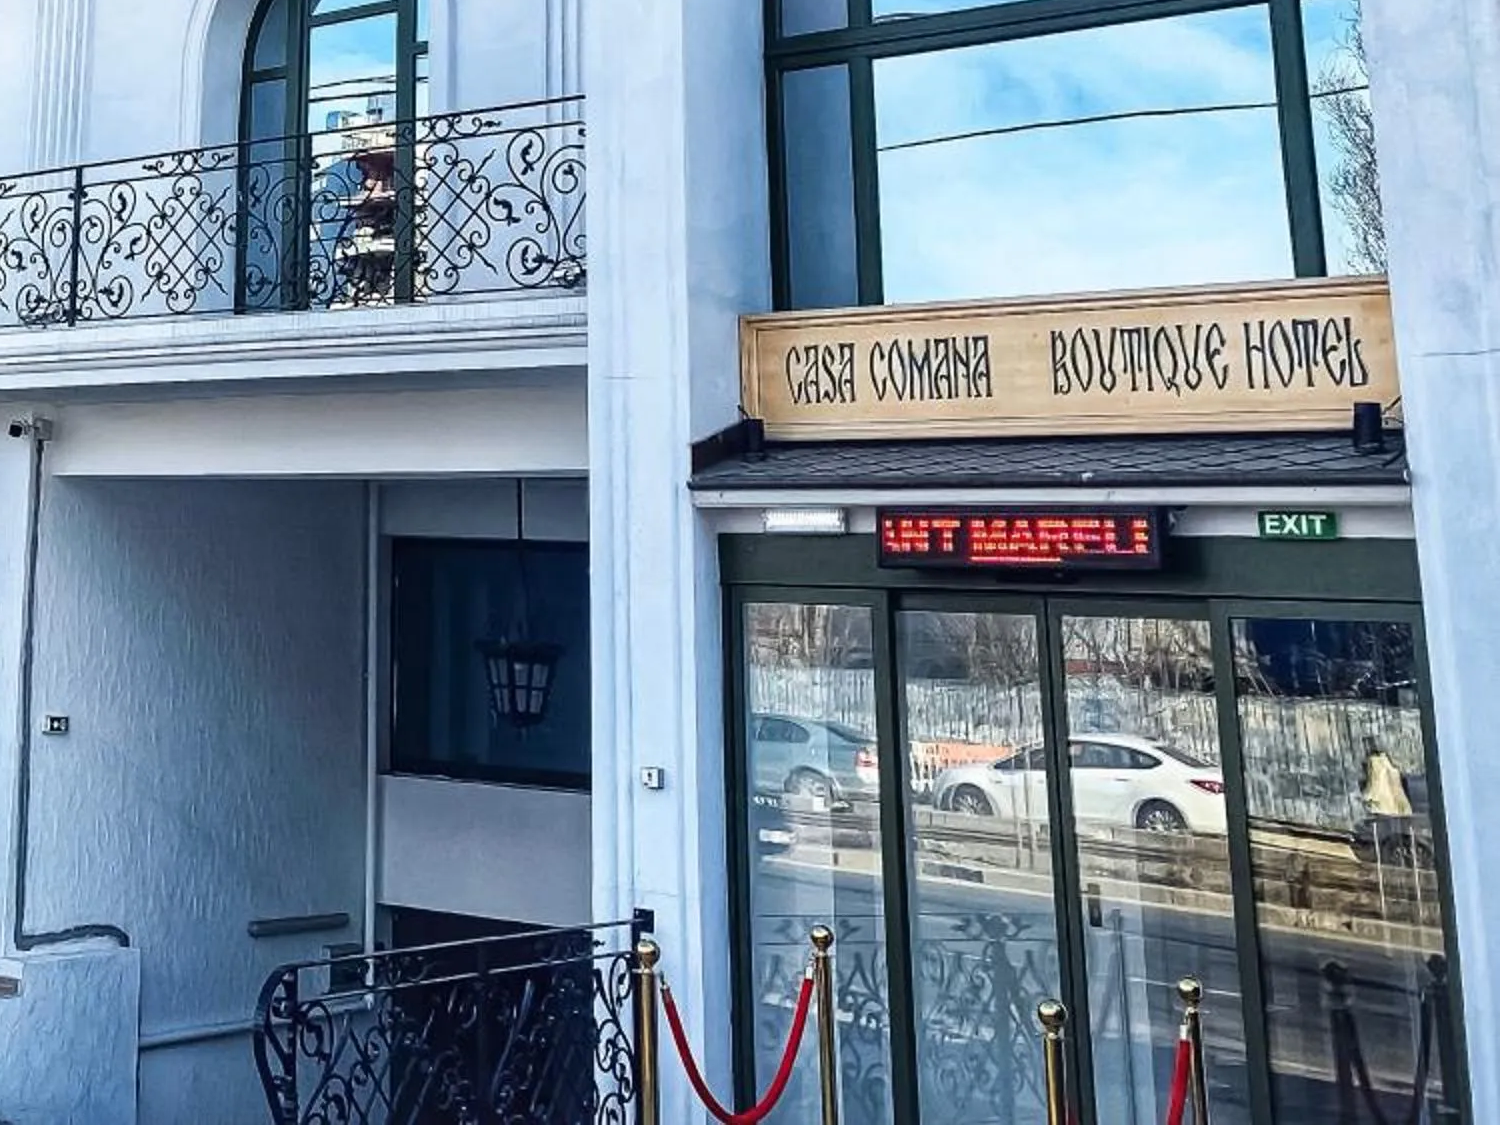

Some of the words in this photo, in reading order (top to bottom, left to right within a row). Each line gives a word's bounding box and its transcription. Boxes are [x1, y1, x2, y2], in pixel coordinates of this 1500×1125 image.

[785, 342, 856, 404] CASA
[870, 335, 993, 402] COMANA
[1051, 323, 1229, 396] BOUTIQUE
[1243, 316, 1369, 389] HOTEL
[1265, 515, 1328, 536] EXIT
